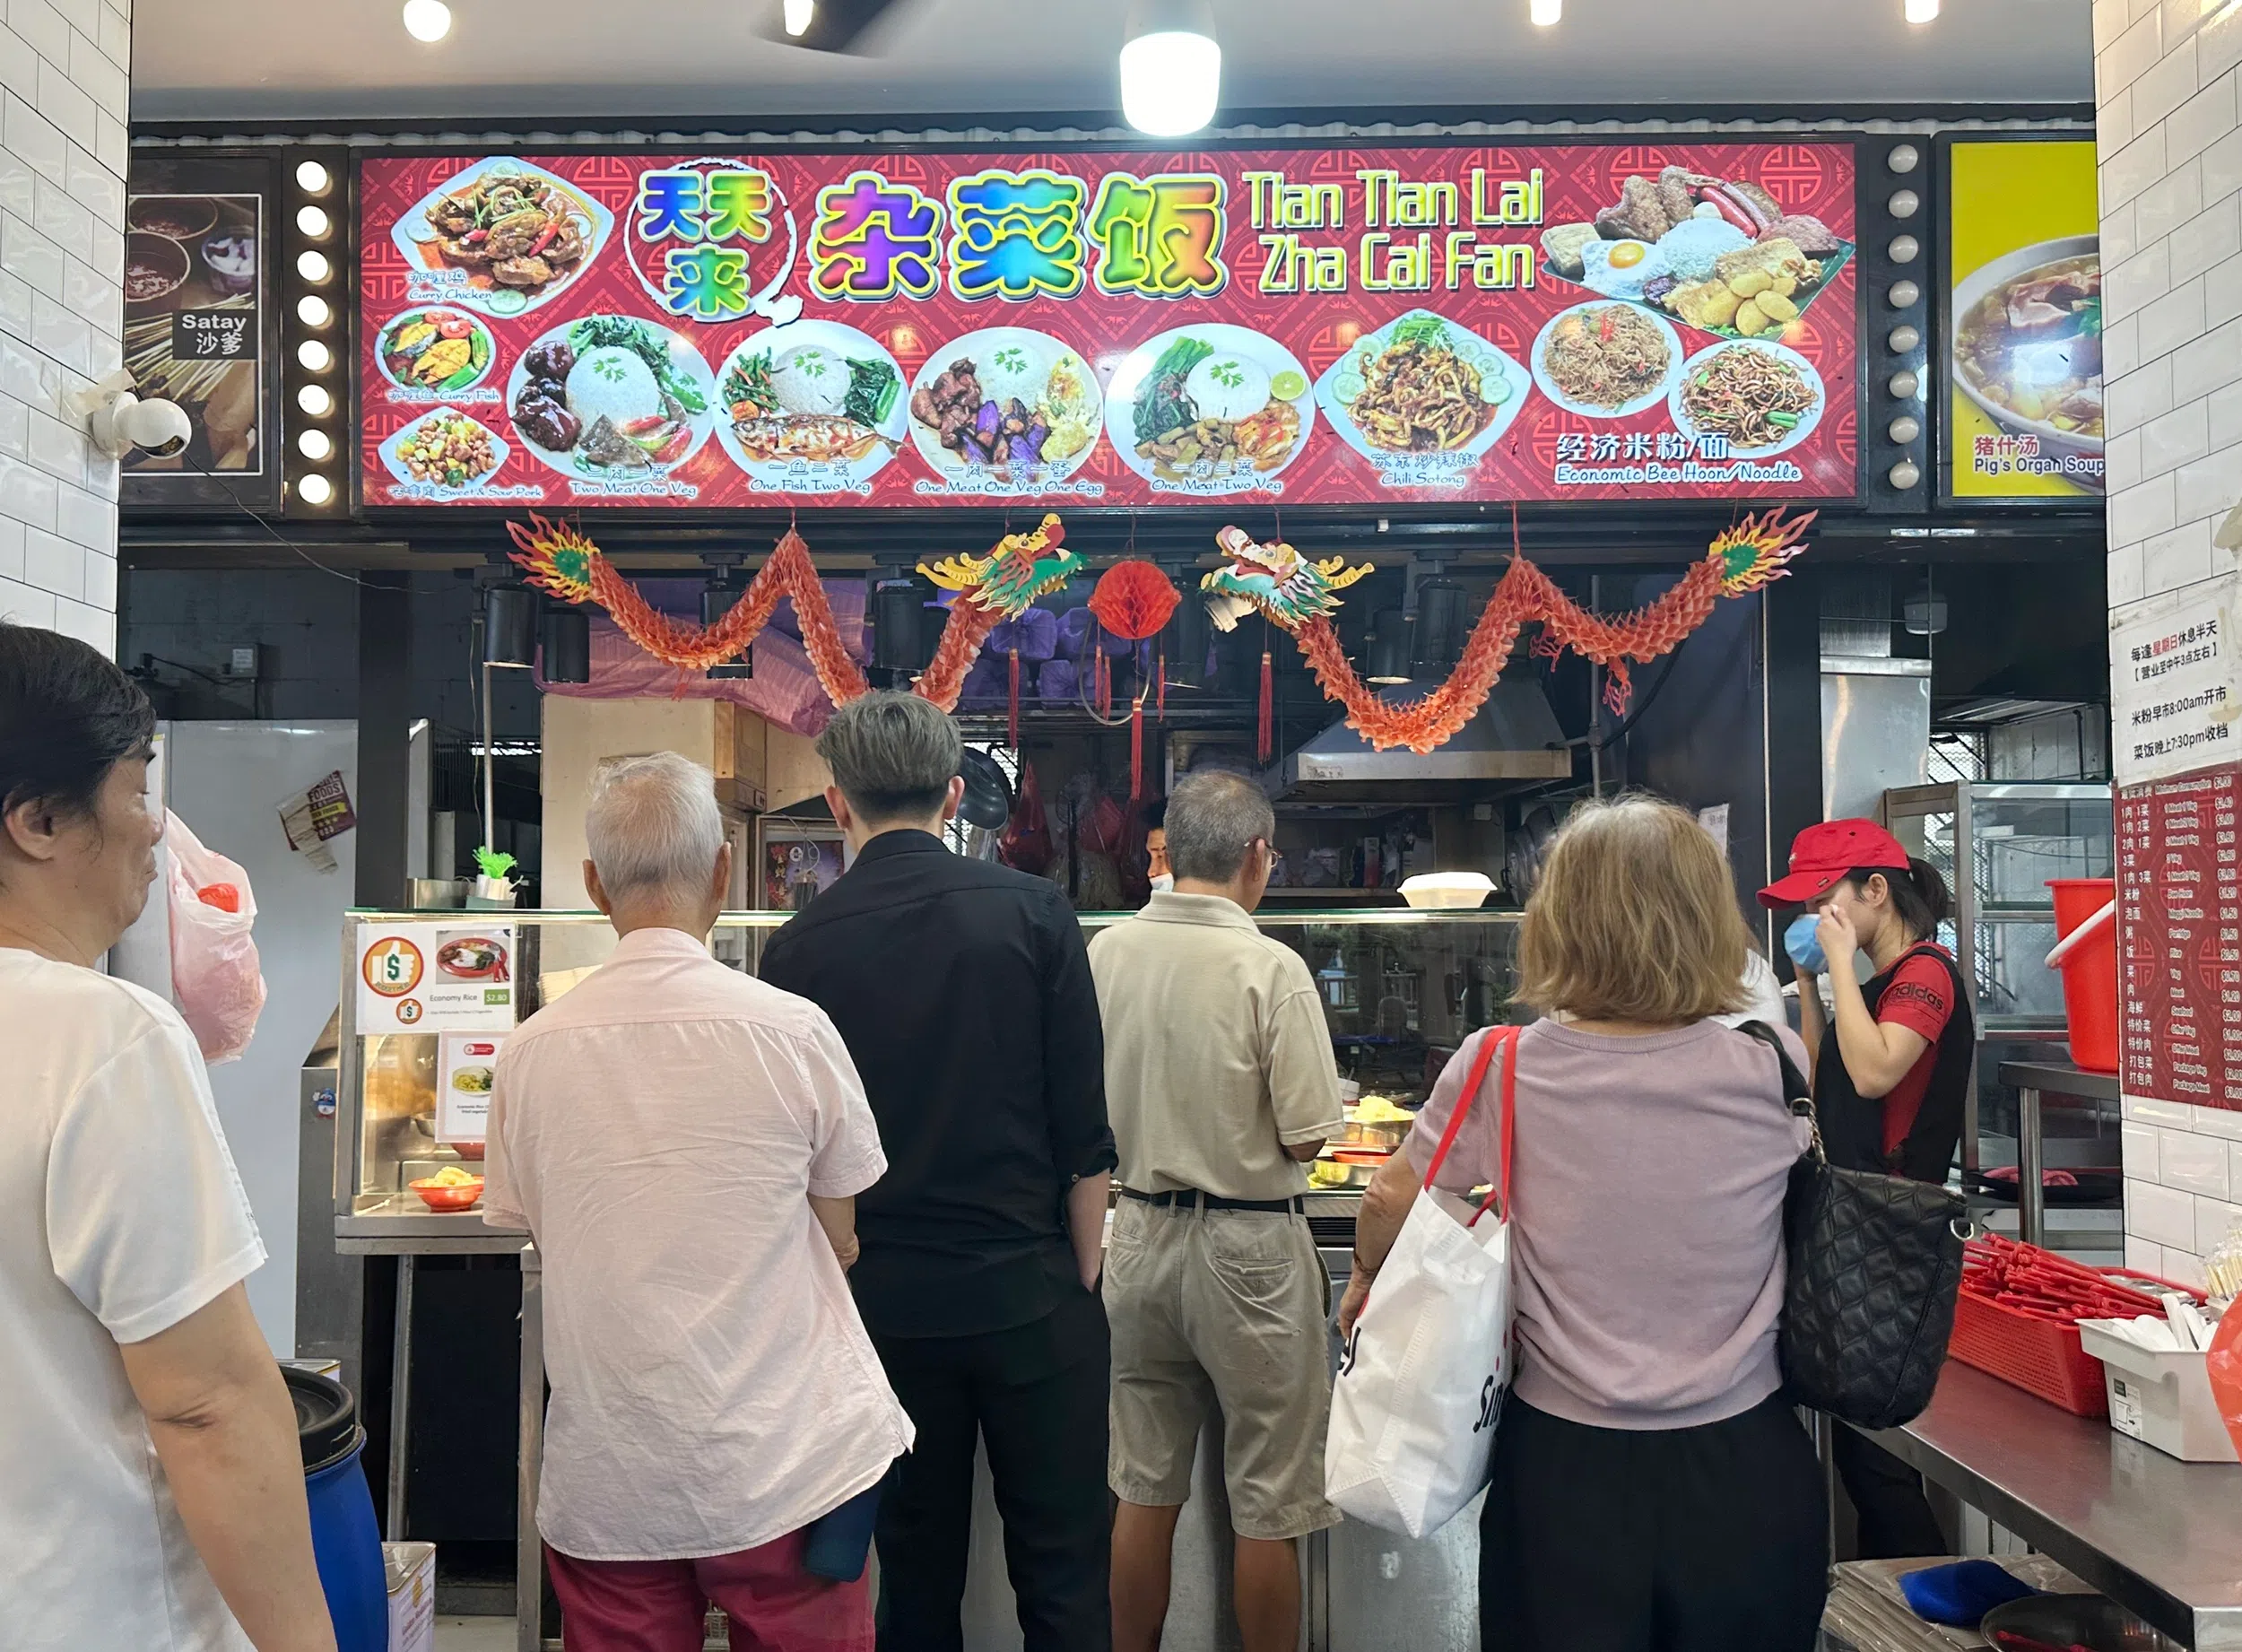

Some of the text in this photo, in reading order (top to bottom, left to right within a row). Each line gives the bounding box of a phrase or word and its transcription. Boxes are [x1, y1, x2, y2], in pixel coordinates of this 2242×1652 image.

[639, 170, 771, 243] 天天
[1241, 168, 1543, 229] Tian Tian Lai
[810, 169, 1228, 301] 杂菜饭
[1258, 231, 1535, 292] Zha Cai Fan
[665, 244, 750, 316] 来
[409, 288, 492, 301] Curry Chicken
[182, 314, 247, 332] Satay
[196, 332, 243, 355] 沙爹
[439, 389, 500, 402] Curry Fish
[1556, 432, 1729, 463] 经济米粉/面
[1975, 435, 2038, 456] 猪什汤
[587, 465, 669, 482] 二肉一菜
[768, 459, 851, 476] 一鱼二菜
[944, 461, 1071, 478] 一肉一菜一蛋
[1171, 459, 1255, 477] 一肉二菜
[1558, 463, 1801, 482] Economic Bee Hoon/Noodle
[1974, 457, 2105, 474] Pig's Organ Soup
[751, 478, 871, 494] One Fish Two Veg
[916, 480, 1103, 495] One Meat One Veg One Egg
[1151, 478, 1282, 492] One Meat Two Veg
[1381, 472, 1464, 488] Chili Sotong
[439, 486, 542, 497] Sweet & Sour Pork
[570, 483, 697, 497] Two Meat One Veg
[2131, 620, 2218, 662] 每逢星期日休息半天
[2132, 685, 2227, 726] 米粉早市8:00am开市
[2133, 722, 2229, 761] 菜饭晚上7:30pm收档
[486, 994, 508, 1002] $2.80
